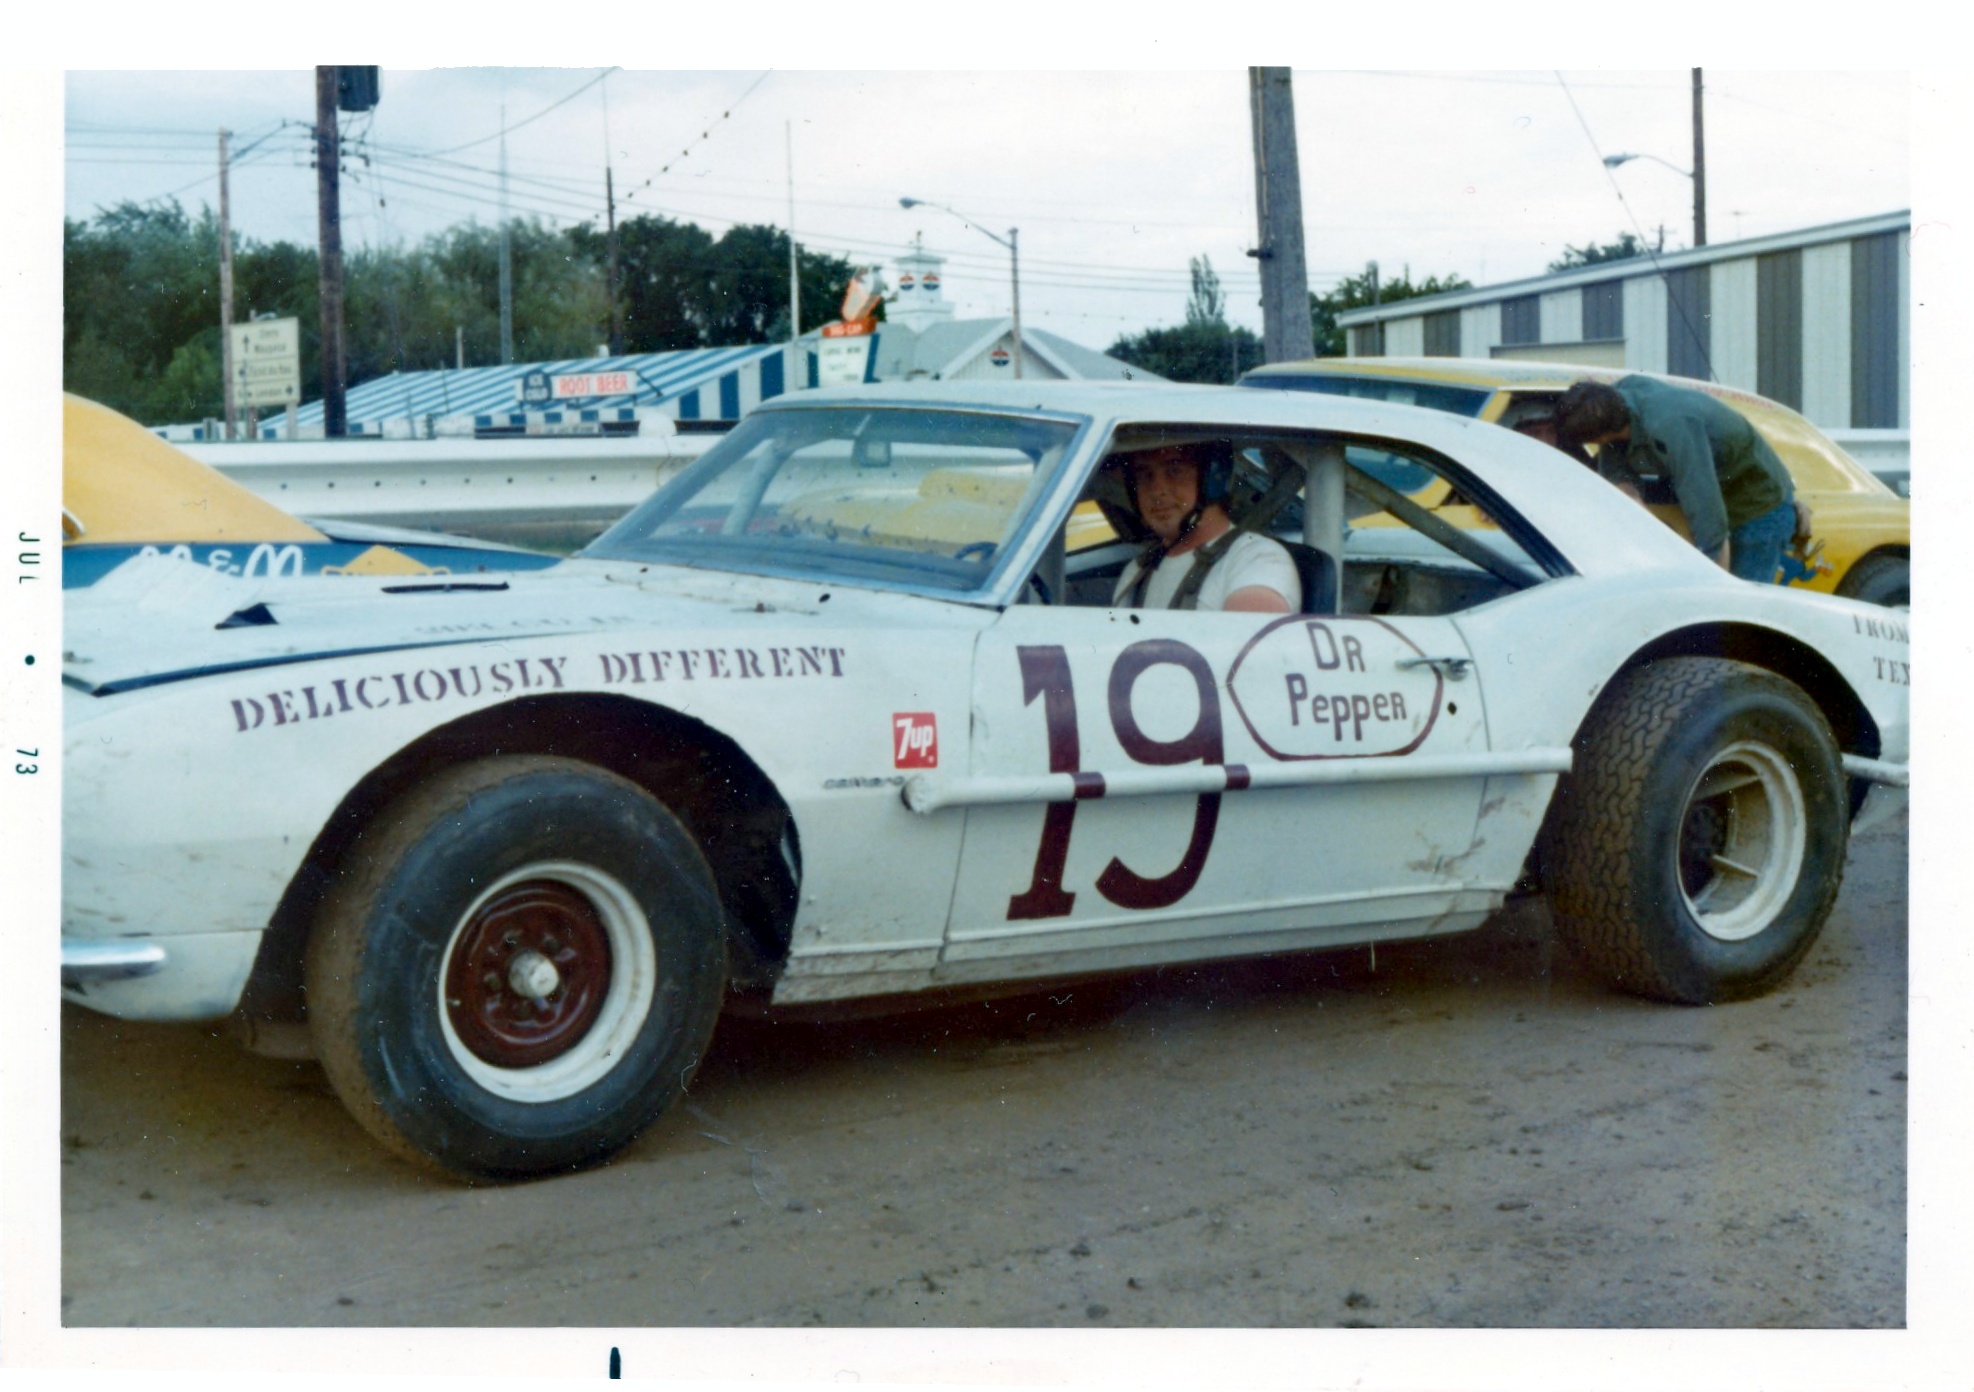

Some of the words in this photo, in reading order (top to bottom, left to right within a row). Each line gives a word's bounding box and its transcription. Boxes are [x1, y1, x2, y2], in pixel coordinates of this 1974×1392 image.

[559, 376, 591, 395] ROOT
[595, 374, 629, 393] BEER
[230, 657, 567, 732] DELICIOUSLY
[599, 646, 846, 684] DIFFERENT
[1006, 637, 1226, 921] 19
